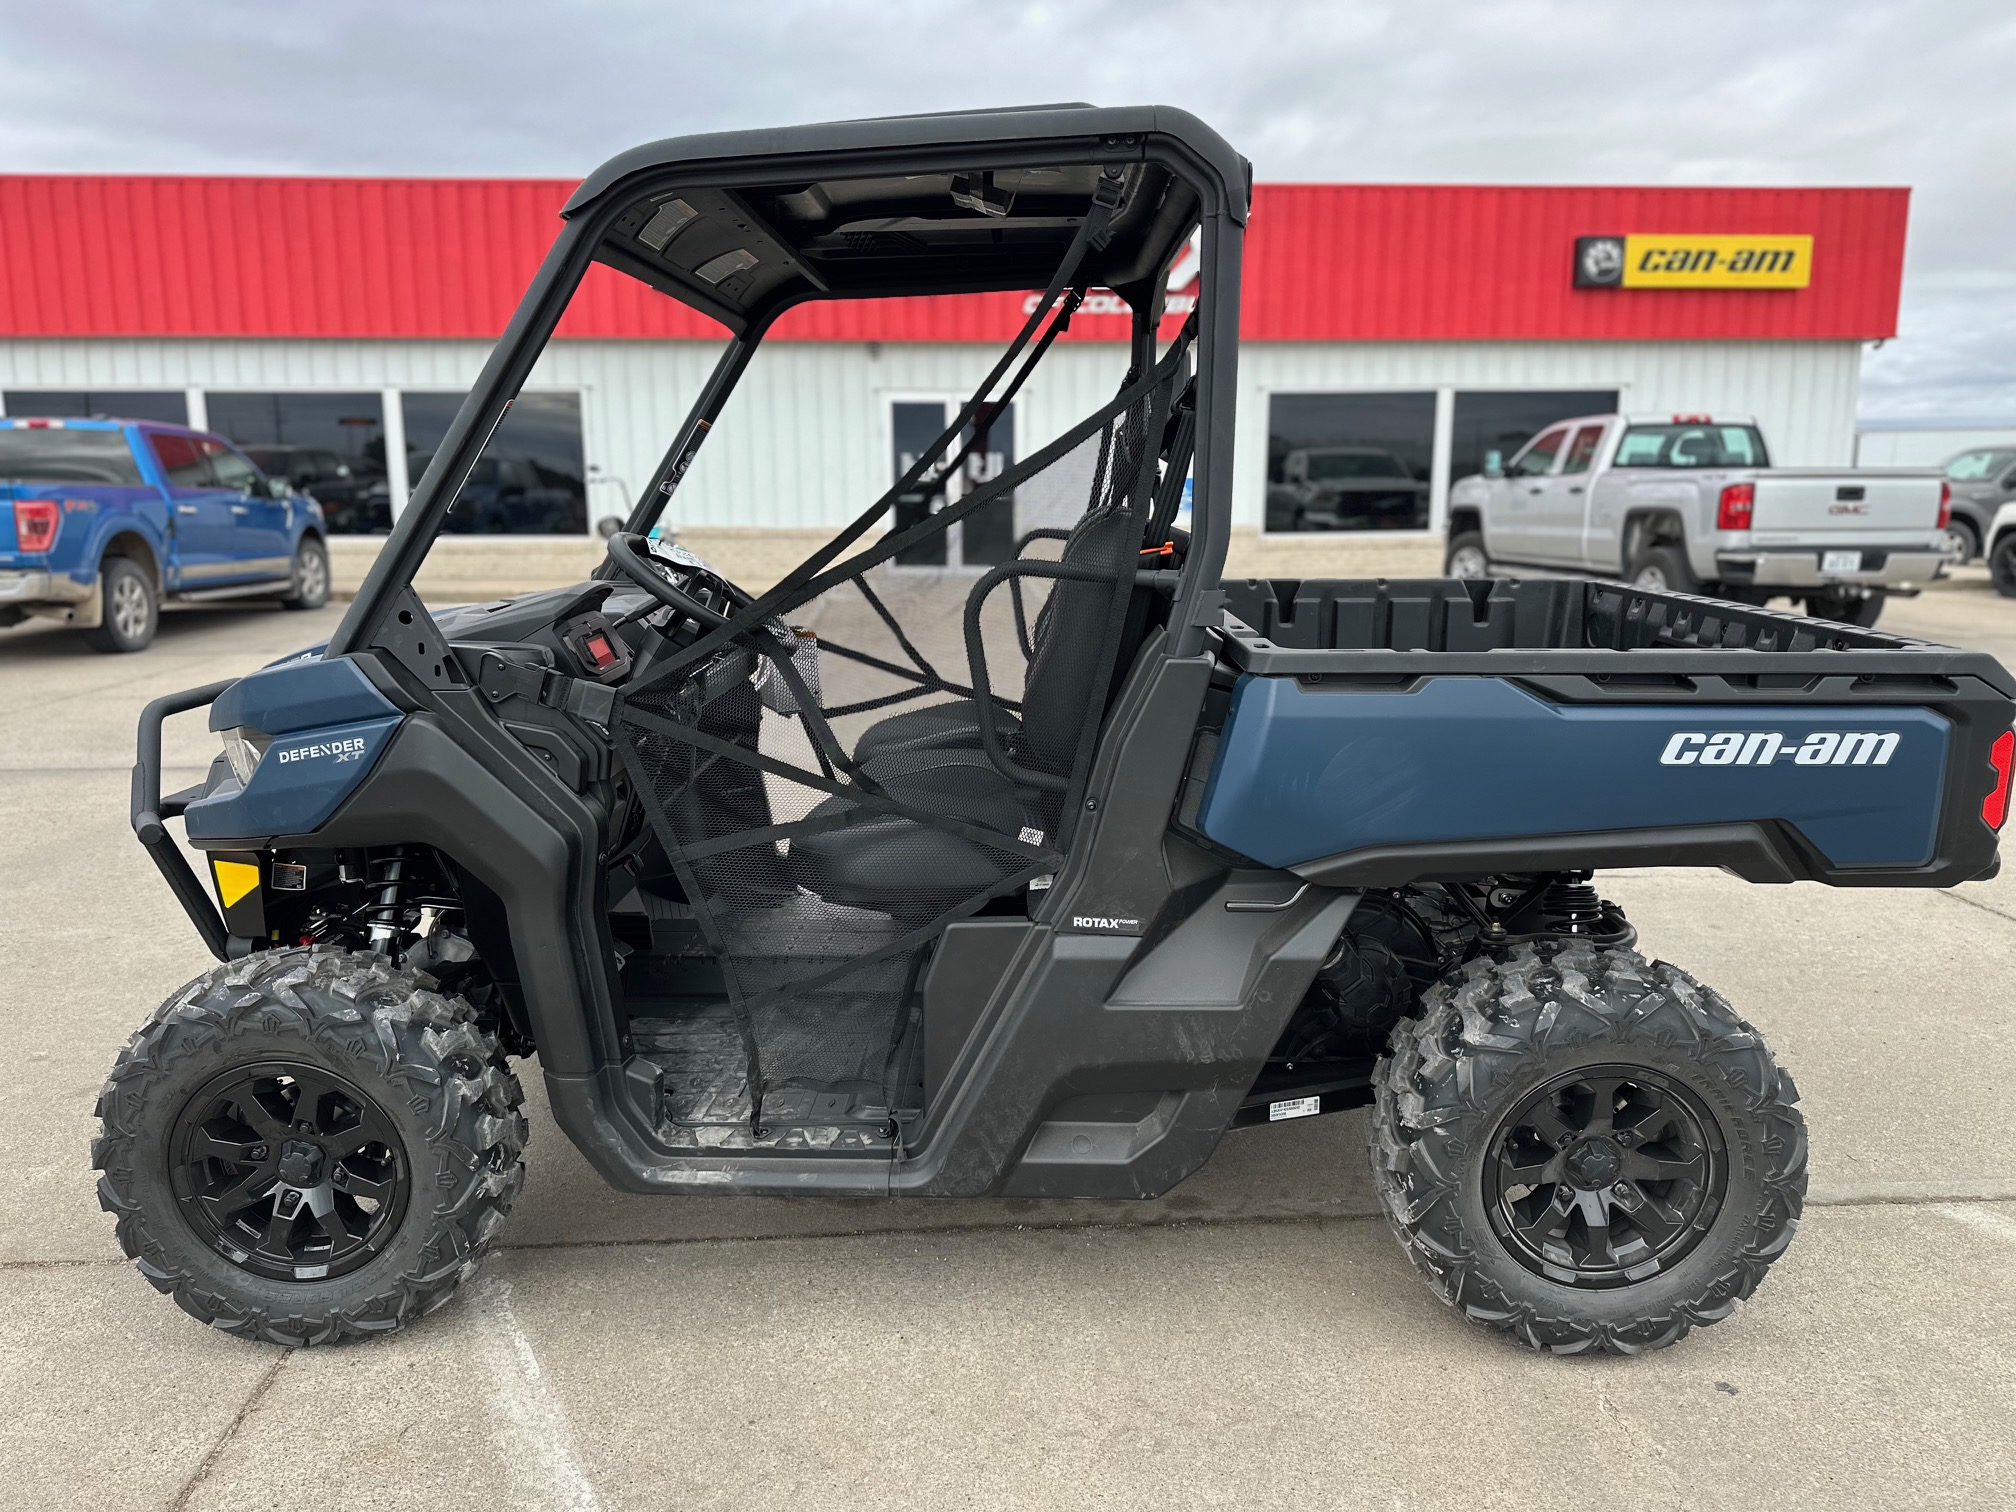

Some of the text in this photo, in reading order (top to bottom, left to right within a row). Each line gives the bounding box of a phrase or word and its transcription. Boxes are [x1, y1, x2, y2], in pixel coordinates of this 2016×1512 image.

[1639, 249, 1795, 273] can-am
[278, 737, 365, 764] DEFENDER
[335, 749, 365, 763] XT
[1660, 732, 1901, 765] can-am
[1073, 916, 1119, 929] ROTAX
[1730, 1116, 1756, 1182] FORCE
